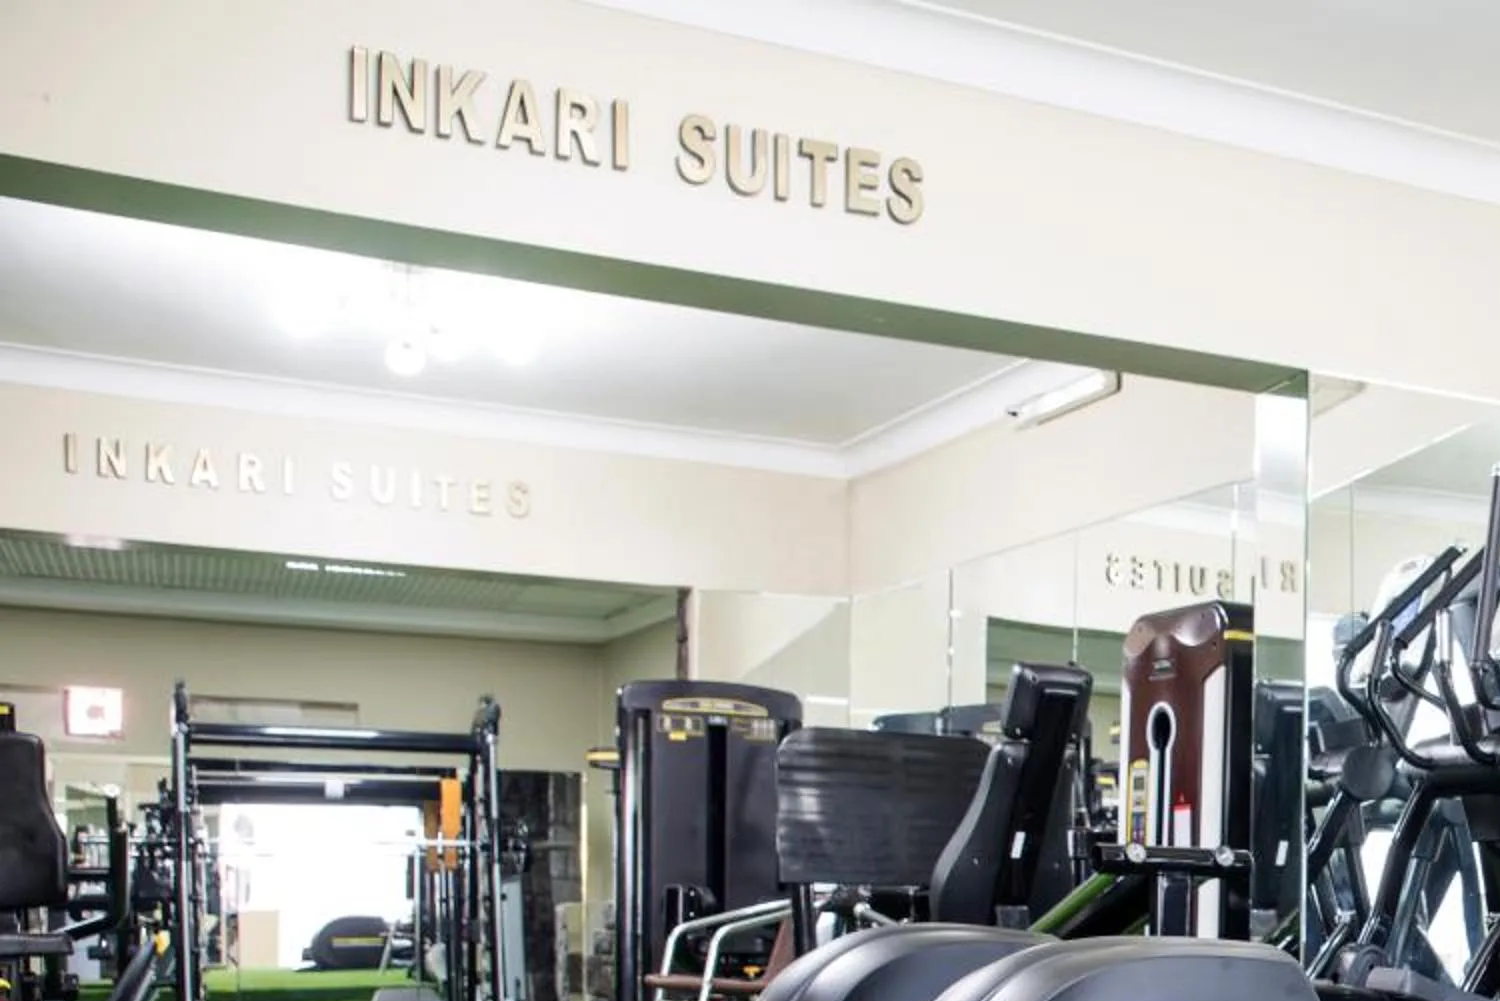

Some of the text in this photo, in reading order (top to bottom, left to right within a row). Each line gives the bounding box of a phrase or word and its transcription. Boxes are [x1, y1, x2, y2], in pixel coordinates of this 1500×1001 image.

[348, 44, 926, 225] INKARI SUITES
[62, 432, 533, 519] INKARI SUITES
